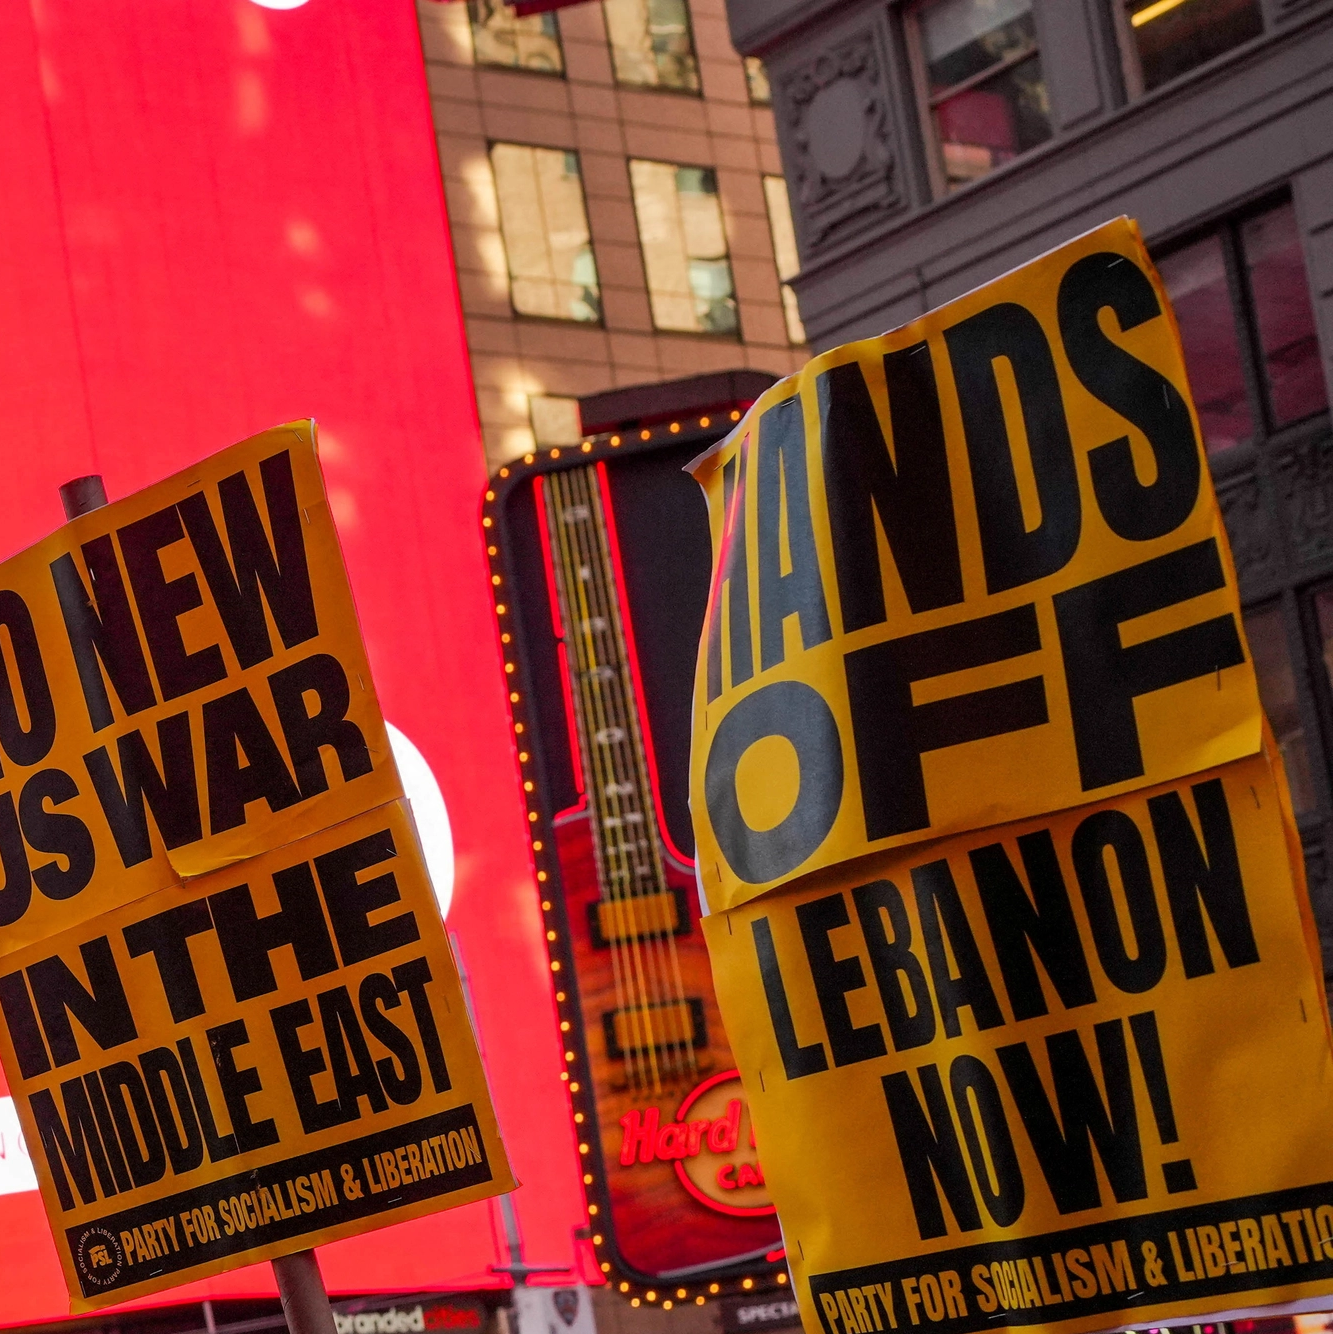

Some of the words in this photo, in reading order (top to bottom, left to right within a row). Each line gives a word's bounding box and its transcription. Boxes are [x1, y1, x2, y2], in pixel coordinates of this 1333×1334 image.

[49, 449, 320, 733] NEW
[83, 652, 374, 869] WAR
[704, 536, 1245, 885] OFF
[122, 829, 421, 1024] THE
[750, 777, 1261, 1081] LEBANON
[27, 1019, 281, 1213] MIDDLE
[269, 956, 452, 1134] EAST
[619, 1098, 741, 1166] Hard
[880, 1010, 1198, 1241] NOW!
[90, 1249, 113, 1269] PSL
[119, 1222, 184, 1267] PARTY
[182, 1209, 221, 1246] FOR
[220, 1170, 338, 1239] SOCIALISM
[342, 1164, 364, 1200] &
[367, 1127, 482, 1195] LIBERATION
[903, 1271, 967, 1326] FOR
[970, 1239, 1139, 1313] SOCIALISM
[1142, 1240, 1167, 1286] &
